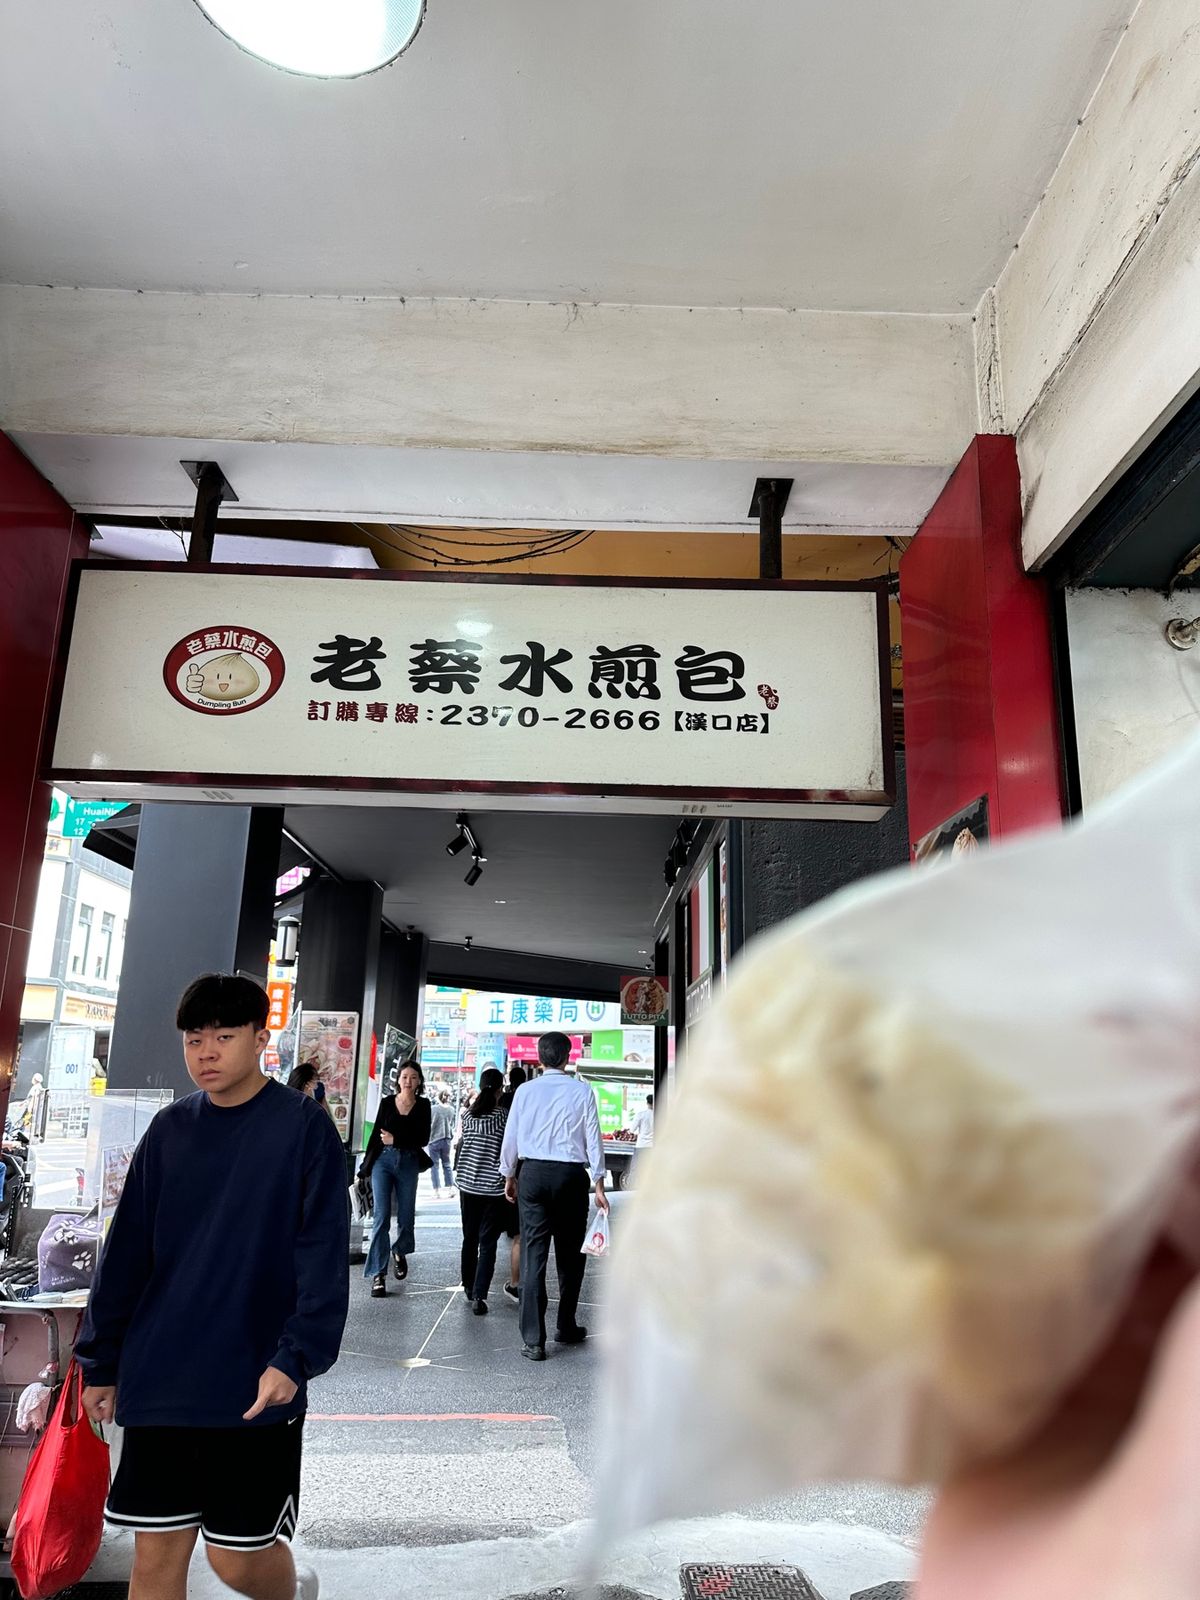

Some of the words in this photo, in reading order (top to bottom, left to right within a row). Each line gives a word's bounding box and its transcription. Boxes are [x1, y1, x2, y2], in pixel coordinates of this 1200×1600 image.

[186, 630, 273, 660] 老蔡水煎包
[310, 635, 746, 701] 老蔡水煎包
[197, 698, 231, 709] Dumpling
[232, 699, 247, 707] Bun
[488, 996, 578, 1024] 正康藥局
[65, 1063, 79, 1074] 001
